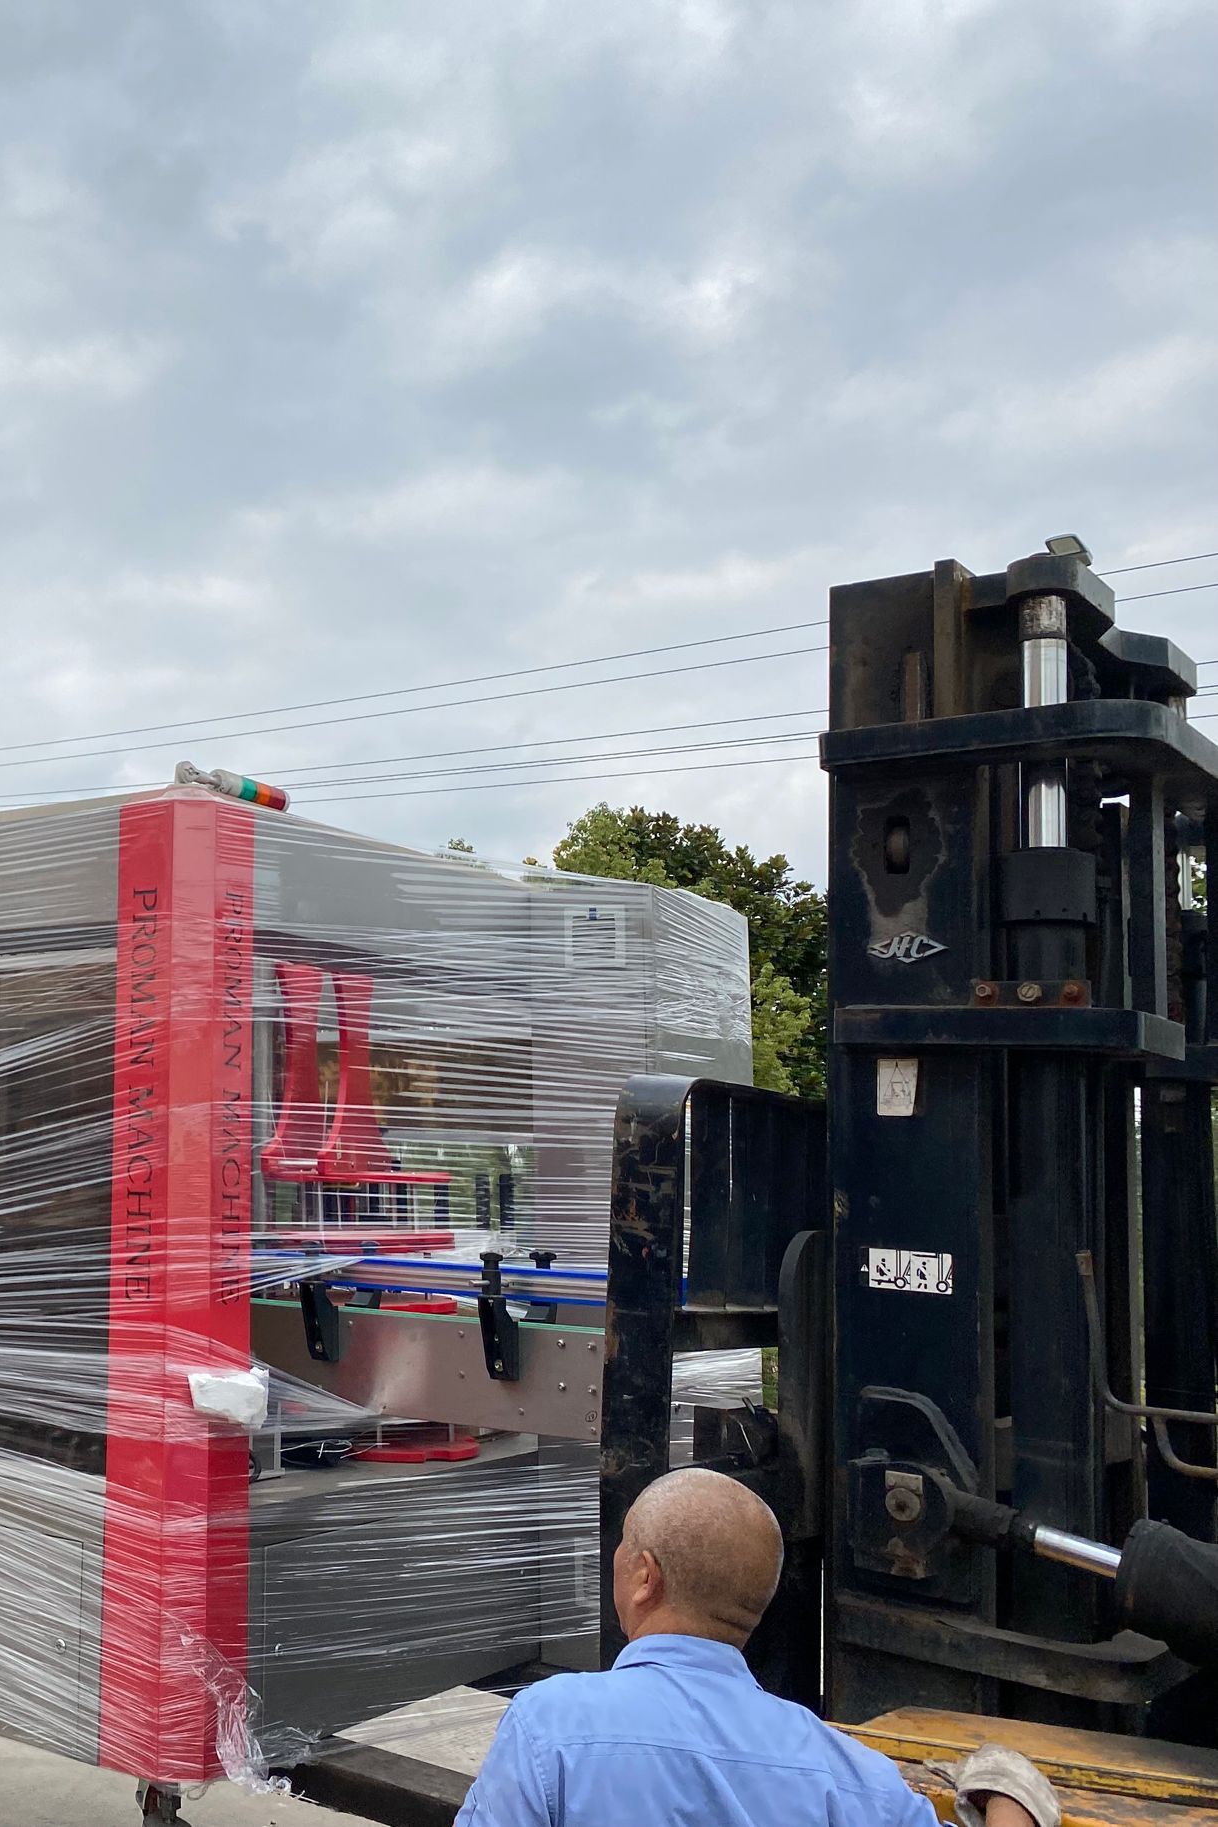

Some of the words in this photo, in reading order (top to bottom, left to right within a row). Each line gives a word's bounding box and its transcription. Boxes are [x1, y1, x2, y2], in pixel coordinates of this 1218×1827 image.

[129, 887, 158, 1072] PROMAN
[222, 888, 244, 1071] PROMAN
[125, 1084, 154, 1300] MACHINE
[221, 1088, 241, 1305] MACHINE
